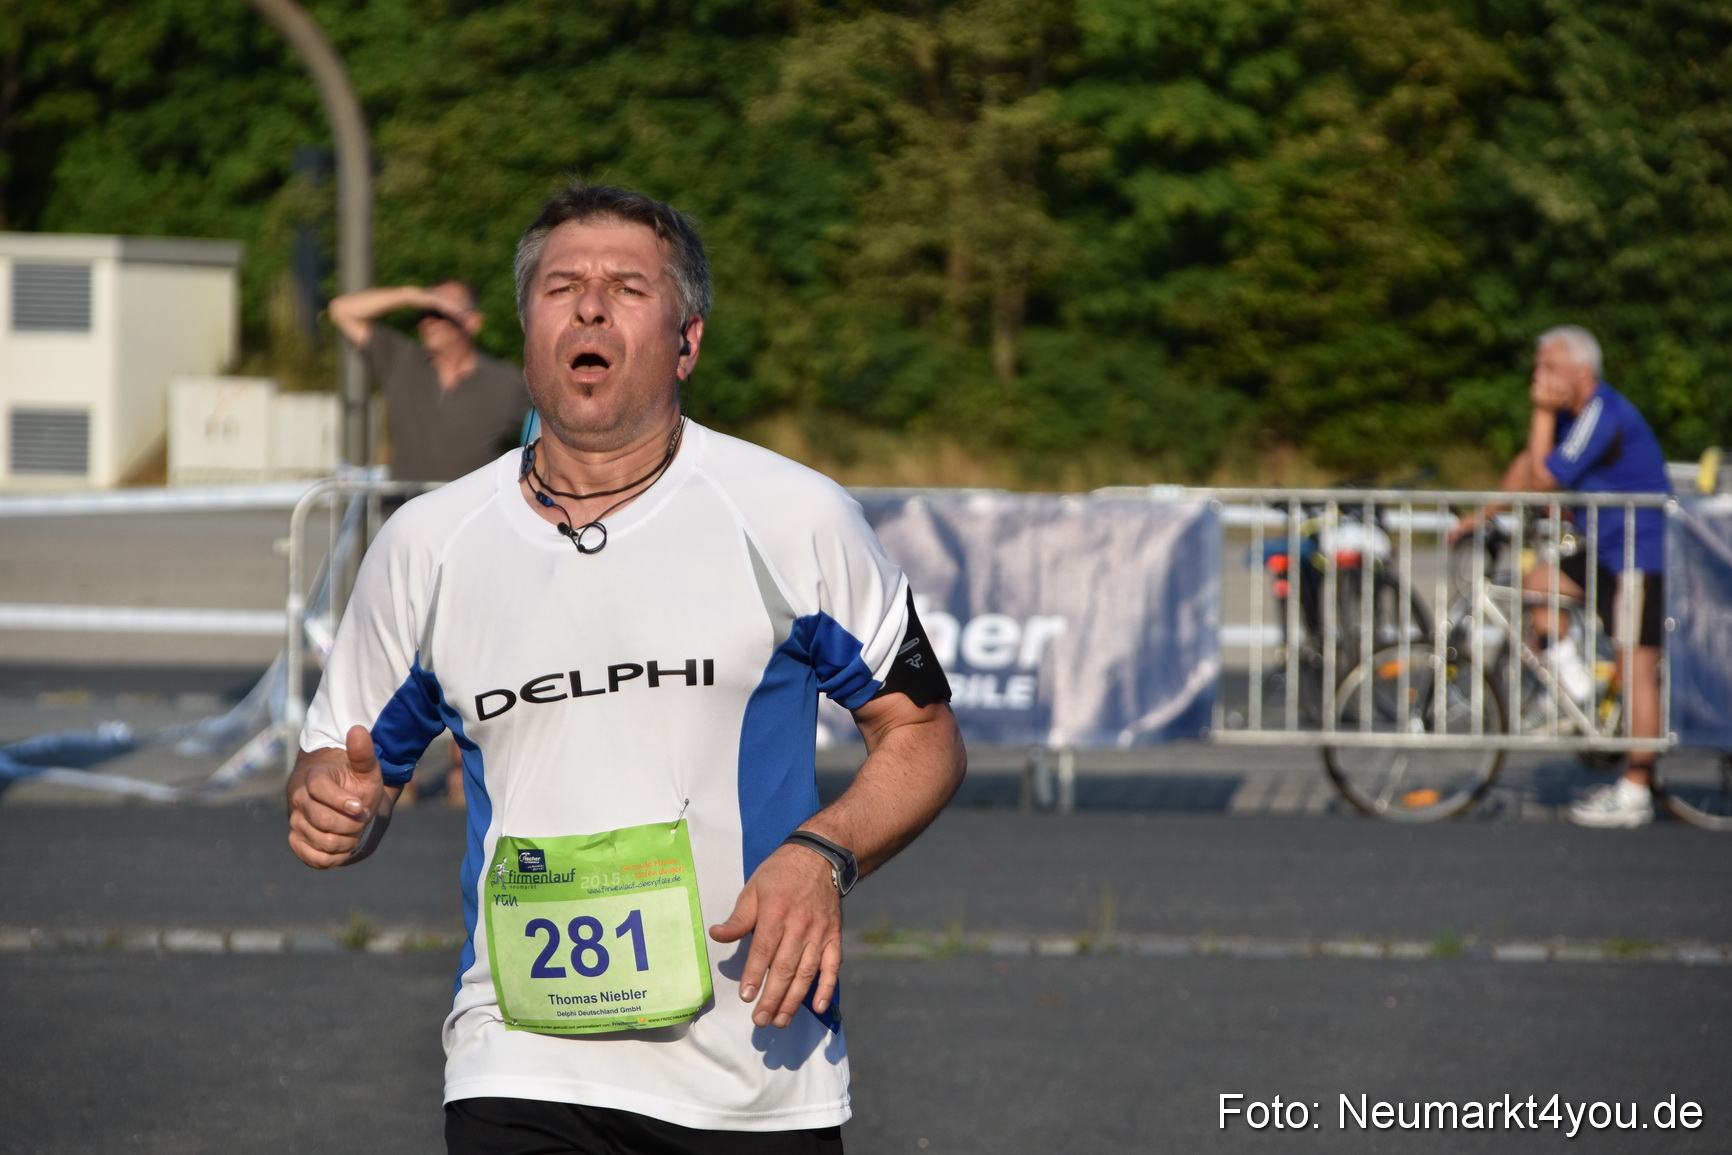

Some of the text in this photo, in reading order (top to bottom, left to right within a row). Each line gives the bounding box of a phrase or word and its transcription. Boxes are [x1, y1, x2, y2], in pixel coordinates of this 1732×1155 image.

[475, 659, 714, 721] DELPHI
[509, 868, 576, 884] firmenlauf
[581, 872, 621, 889] 2015
[525, 909, 649, 979] 281
[548, 989, 647, 1005] Thomas Niebler
[578, 1008, 619, 1016] Deutschland
